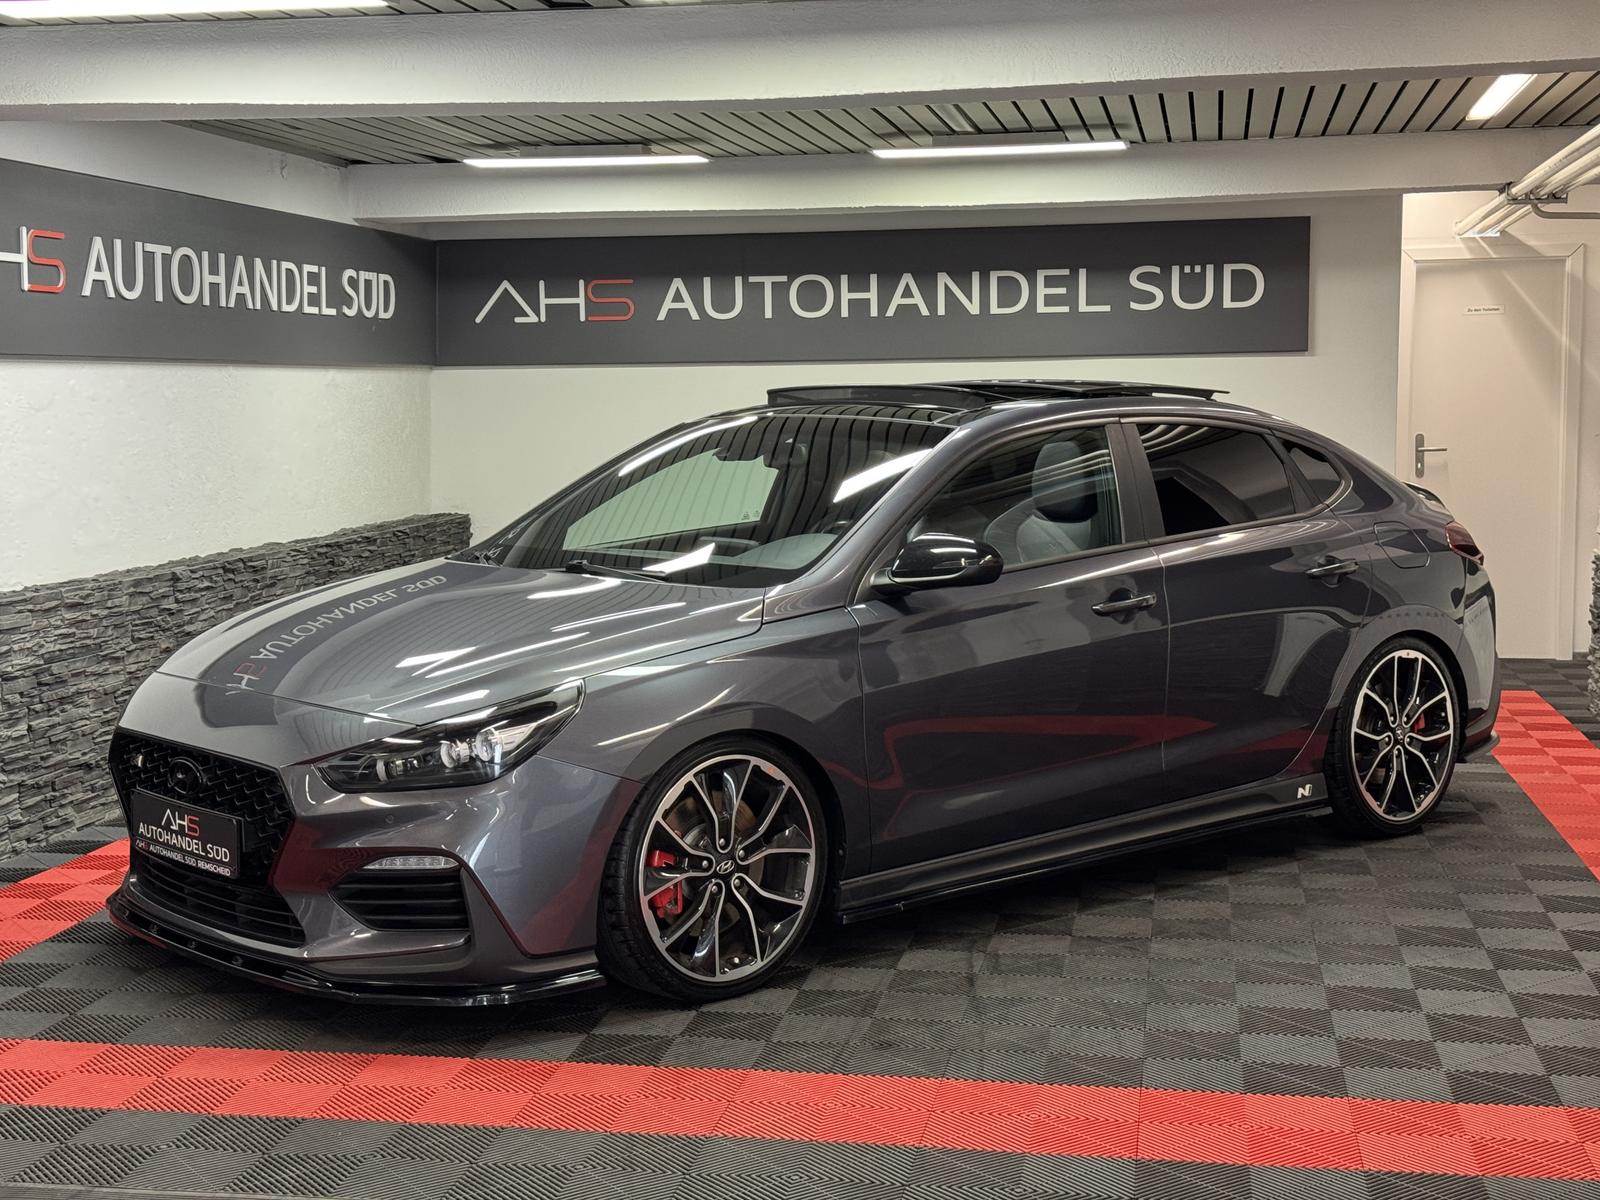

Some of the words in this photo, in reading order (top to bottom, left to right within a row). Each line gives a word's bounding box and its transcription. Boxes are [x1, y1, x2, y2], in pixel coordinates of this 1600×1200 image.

[81, 236, 337, 316] AUTOHANDEL
[342, 268, 396, 319] SÜD
[475, 278, 635, 323] AHS
[656, 268, 1112, 322] AUTOHANDEL
[1128, 262, 1266, 312] SÜD
[138, 821, 206, 856] AUTOHANDEL
[206, 843, 230, 862] SÜD
[161, 808, 200, 836] AHS
[149, 844, 185, 863] AUTOHANDEL
[197, 860, 231, 876] REMSCHEID
